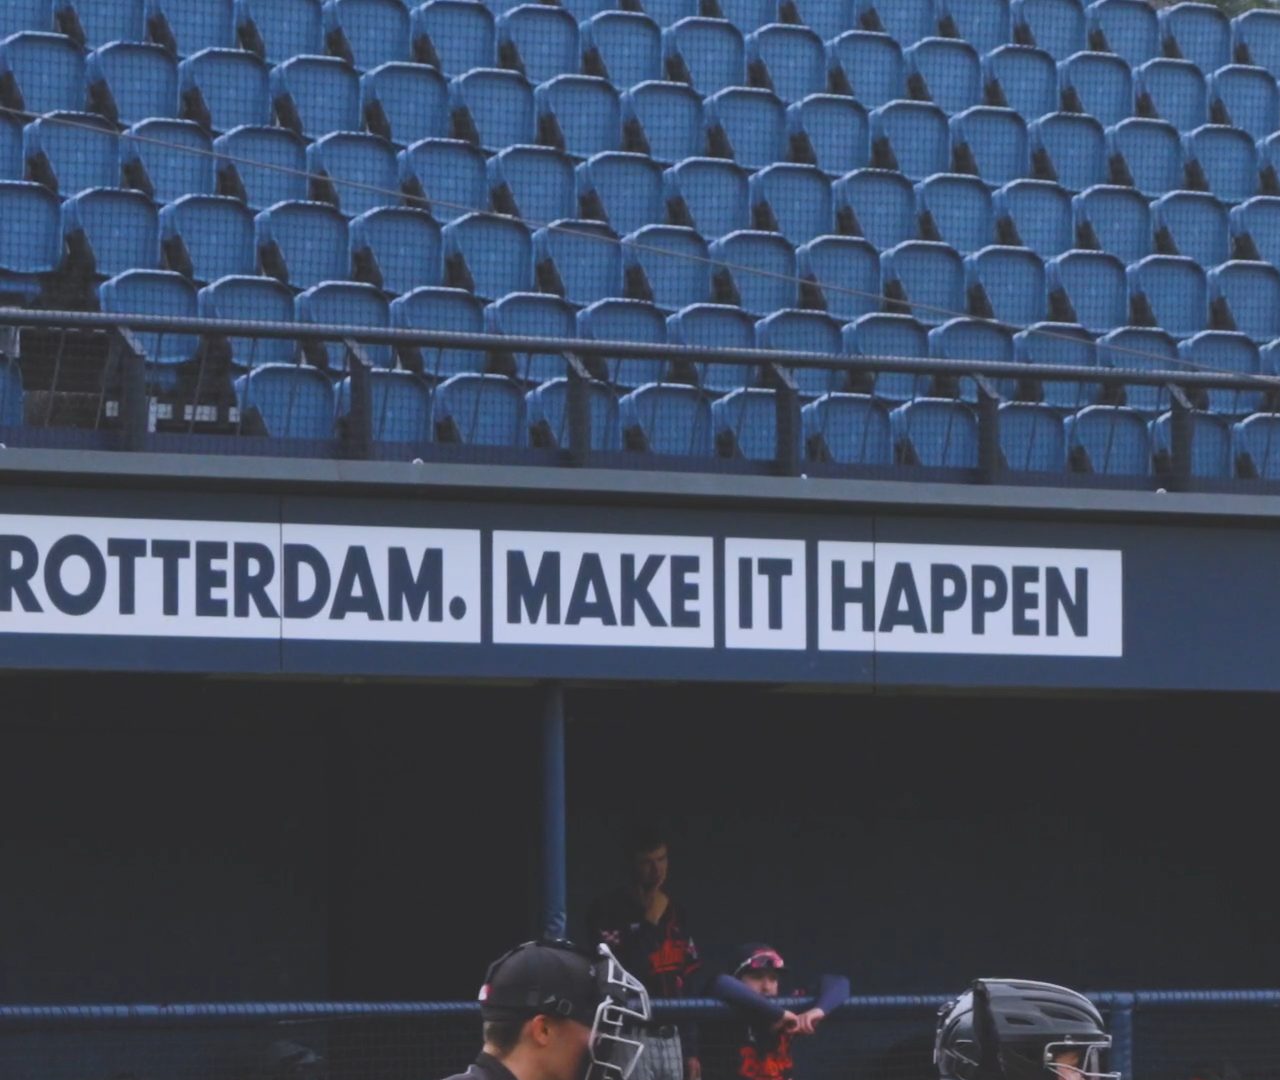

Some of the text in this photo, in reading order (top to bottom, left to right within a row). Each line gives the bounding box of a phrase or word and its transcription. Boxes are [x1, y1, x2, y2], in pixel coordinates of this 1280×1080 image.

[0, 533, 1089, 638] ROTTERDAM. MAKE IT HAPPEN
